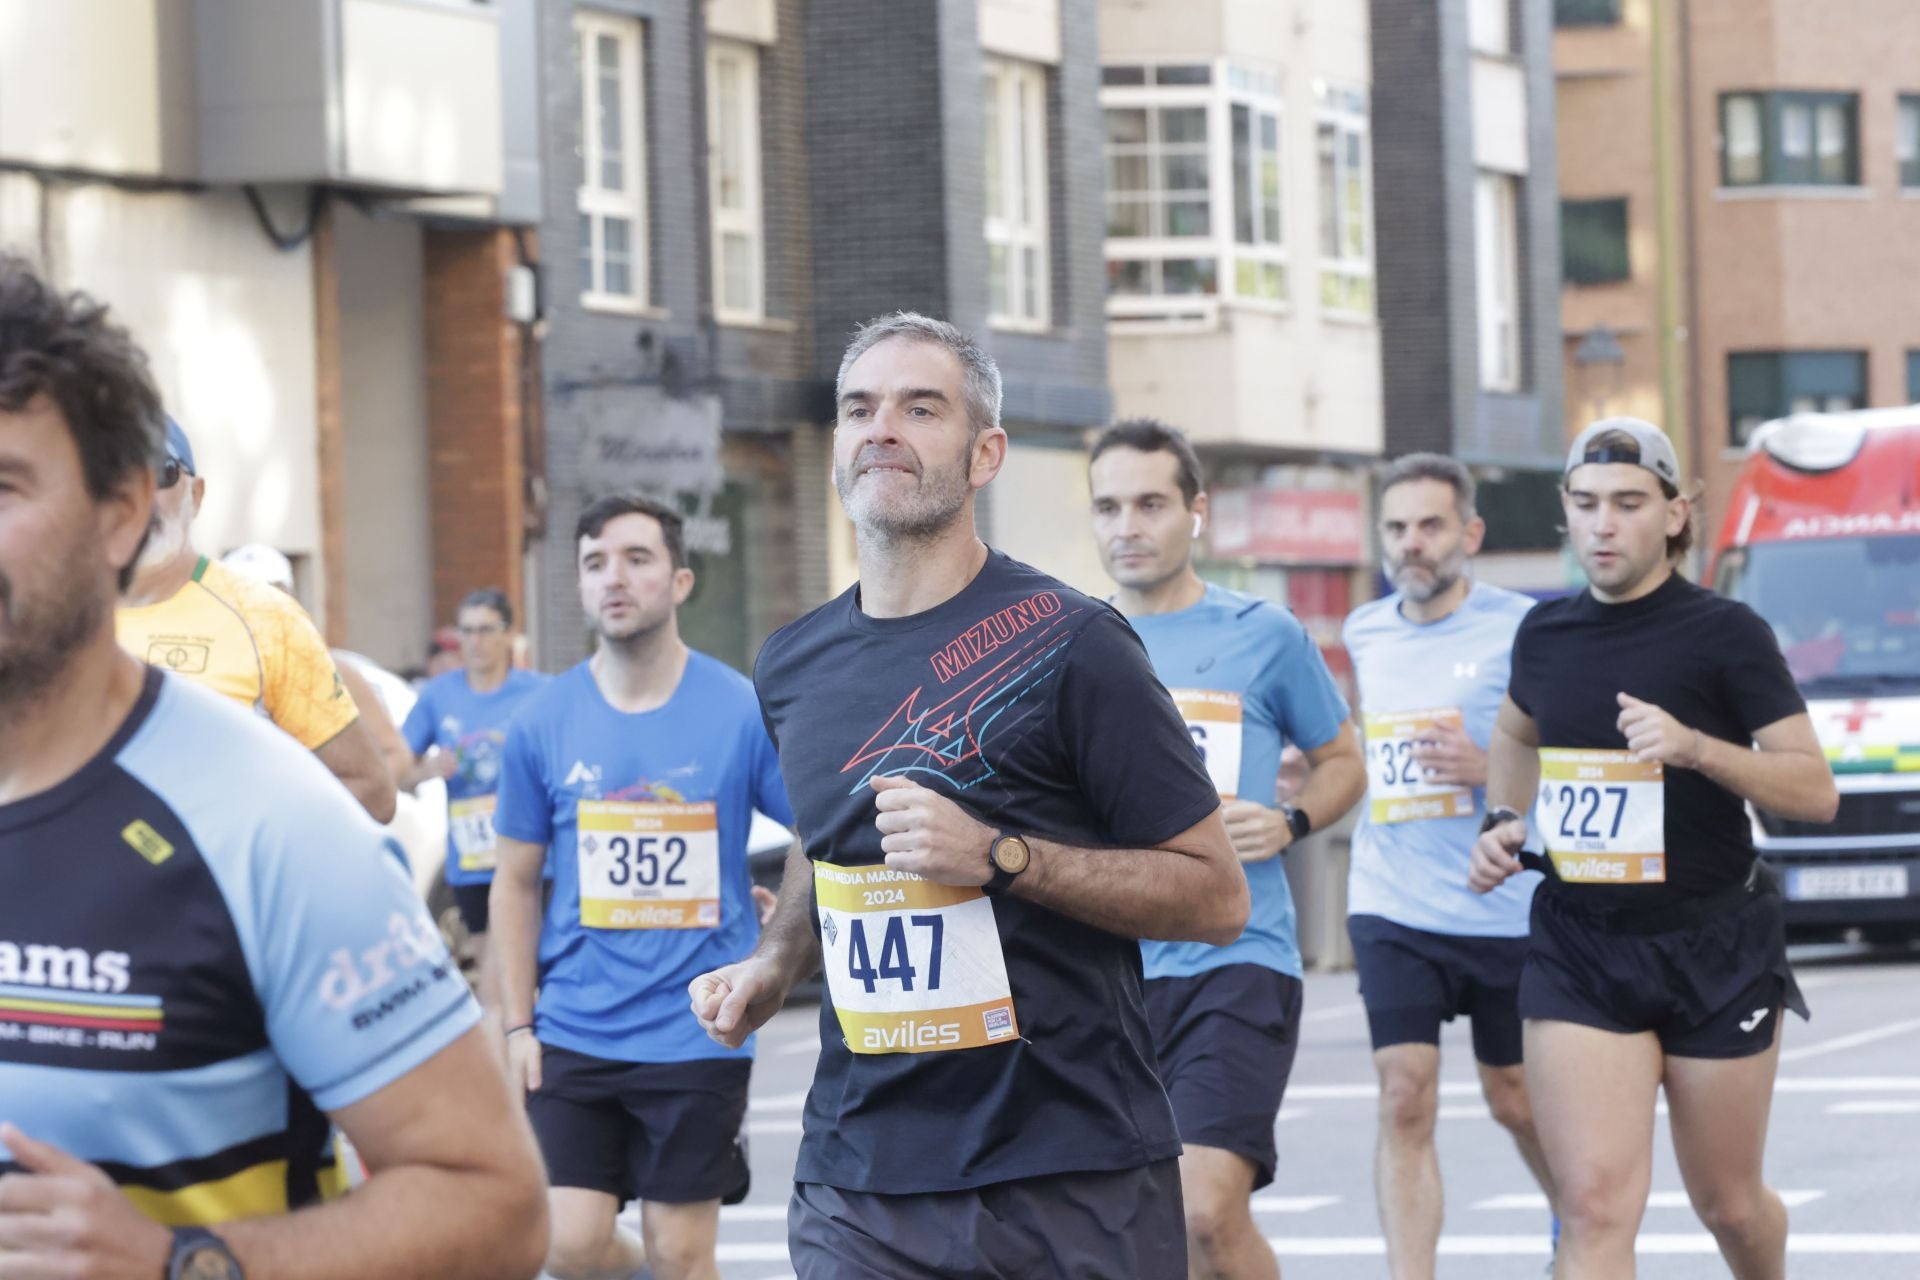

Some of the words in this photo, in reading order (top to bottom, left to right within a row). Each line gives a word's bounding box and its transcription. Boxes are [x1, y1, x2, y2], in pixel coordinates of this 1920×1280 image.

[930, 591, 1061, 684] MIZUNO
[1381, 739, 1439, 785] 32
[1559, 785, 1628, 838] 227
[608, 836, 688, 886] 352
[863, 889, 905, 906] 2024
[848, 913, 944, 994] 447
[863, 1019, 961, 1049] avilés
